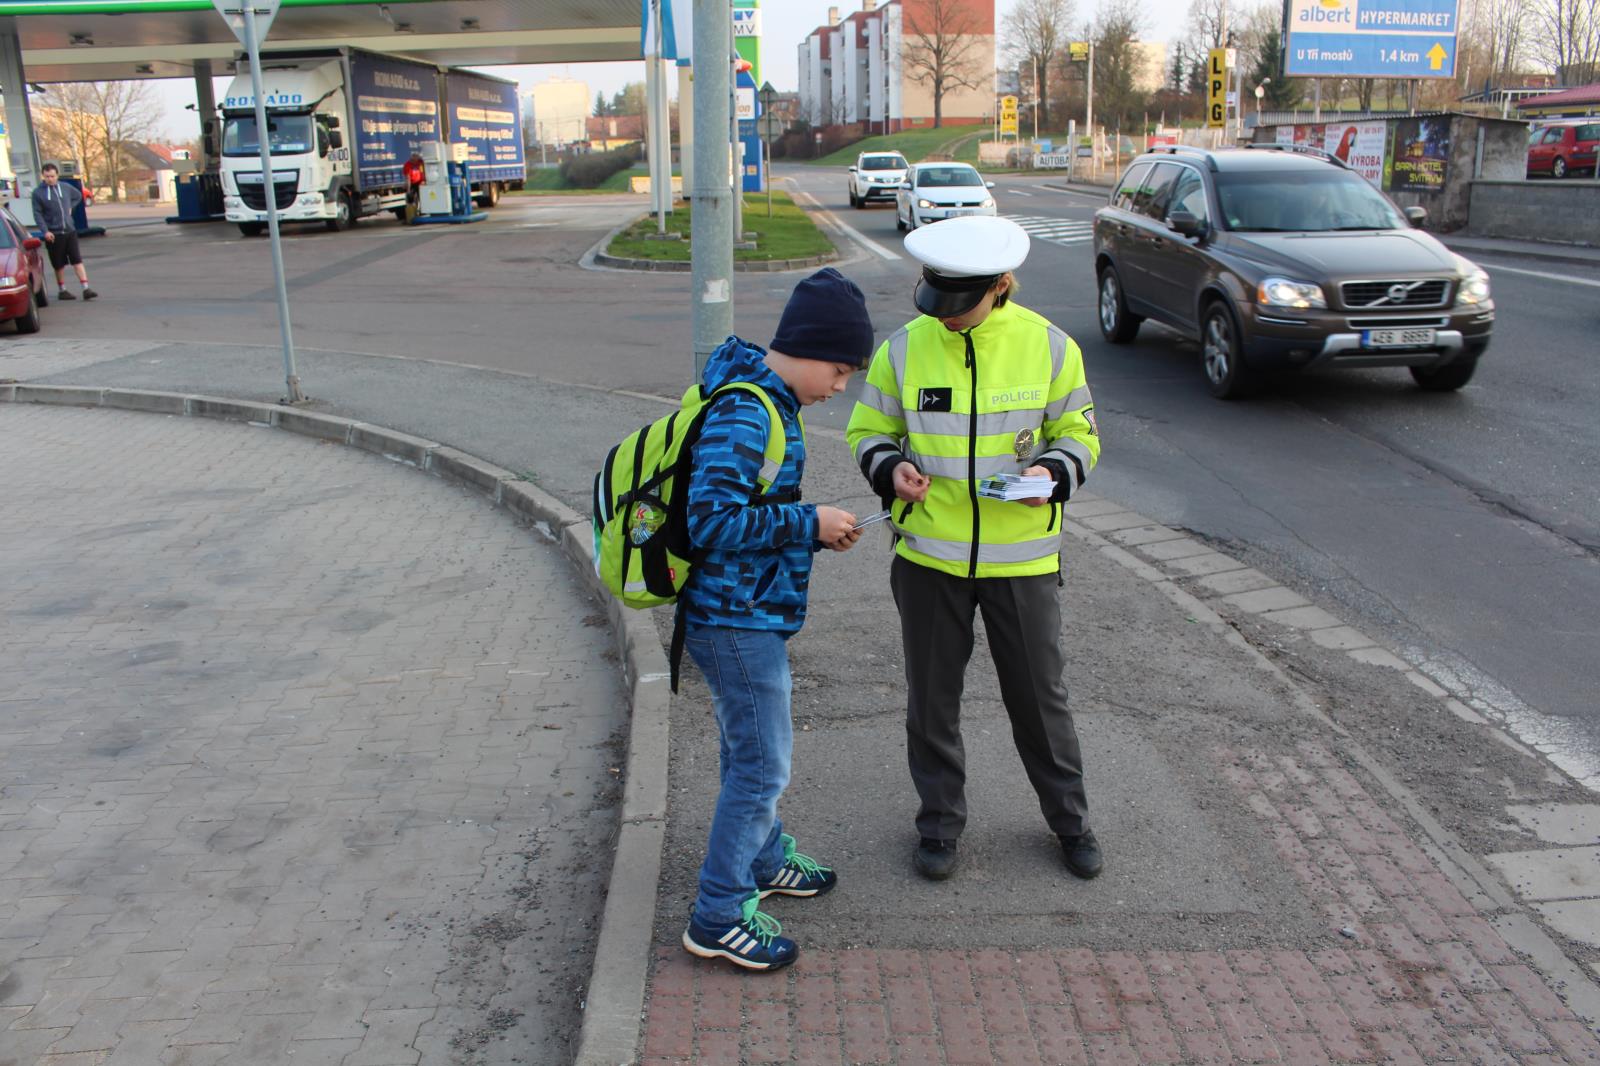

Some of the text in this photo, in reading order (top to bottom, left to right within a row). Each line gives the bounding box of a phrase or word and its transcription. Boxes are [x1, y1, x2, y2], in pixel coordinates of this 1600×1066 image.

[1299, 6, 1450, 27] albert HYPERMARKET
[733, 24, 755, 34] MV
[1297, 49, 1305, 61] U
[1320, 49, 1353, 62] mostů
[1399, 49, 1419, 63] km
[1212, 56, 1222, 121] LPG
[1039, 155, 1069, 166] AUTOBA
[1351, 153, 1380, 167] VÝROBA
[992, 390, 1041, 405] POLICIE
